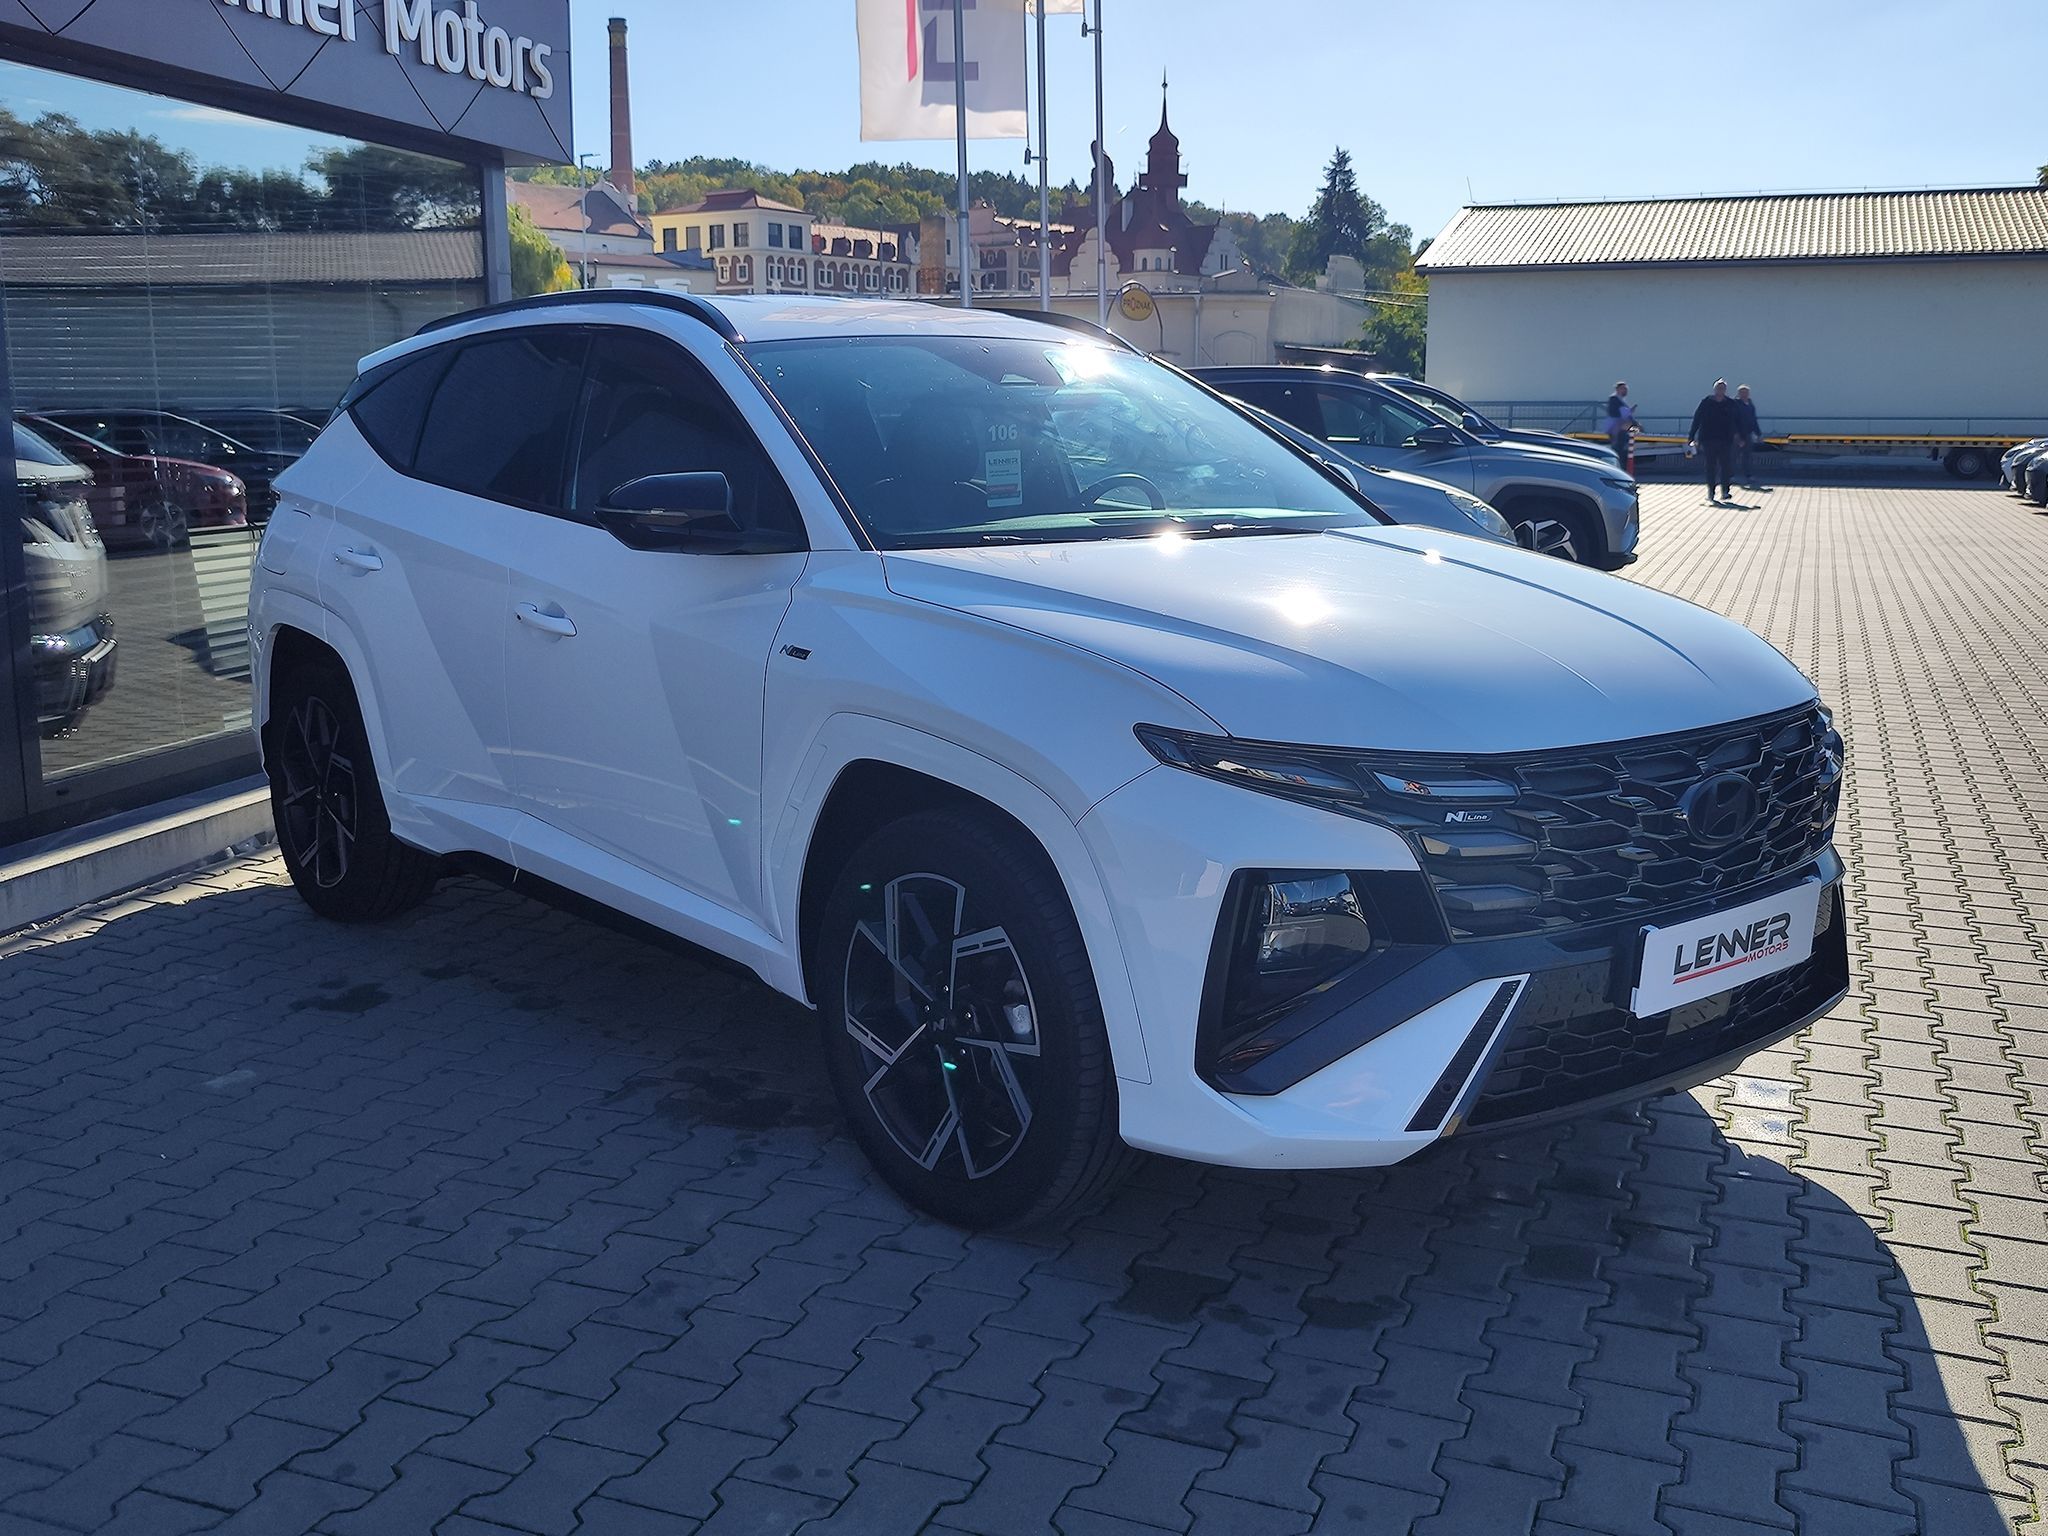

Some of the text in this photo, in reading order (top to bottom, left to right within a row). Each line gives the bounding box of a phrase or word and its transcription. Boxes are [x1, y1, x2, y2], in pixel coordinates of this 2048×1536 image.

[383, 0, 553, 99] Motors
[988, 423, 1018, 441] 106
[1445, 811, 1465, 822] N
[1673, 912, 1791, 976] LENNER
[1747, 939, 1789, 963] MOTORS
